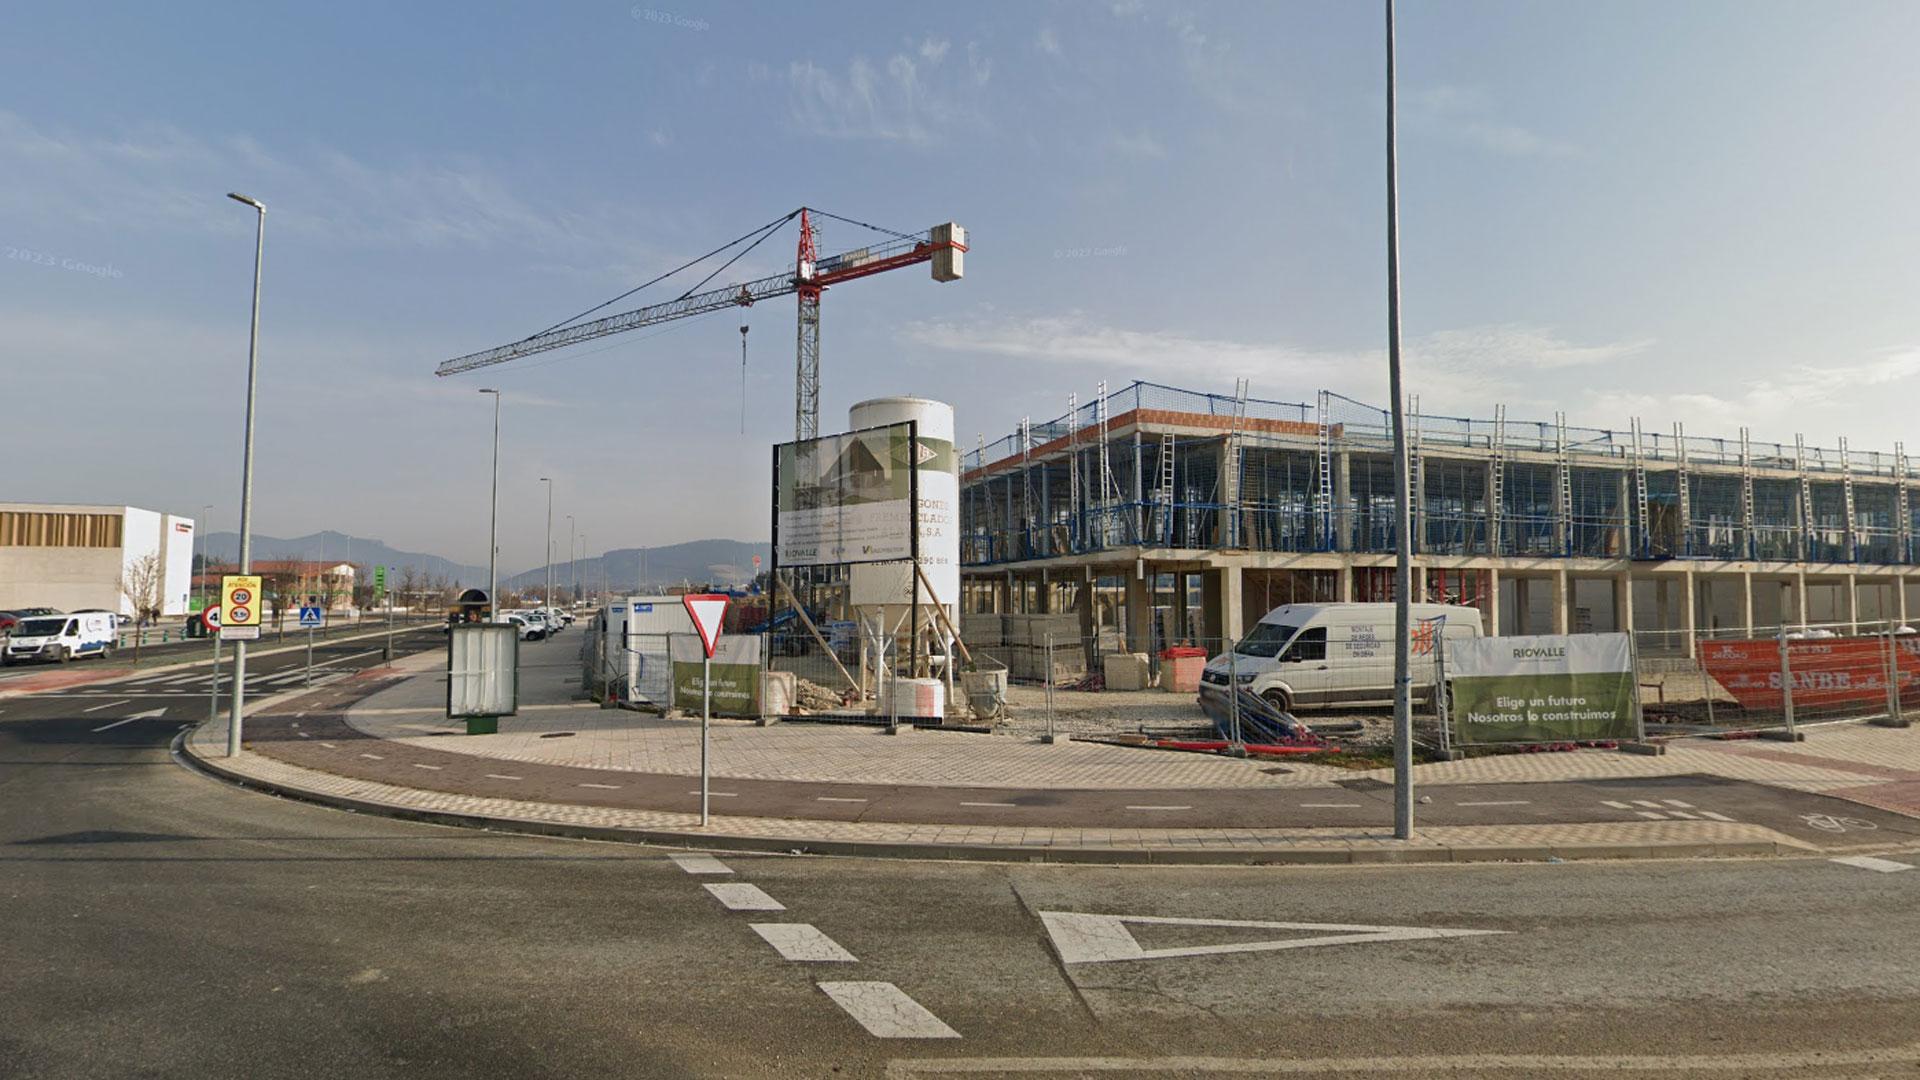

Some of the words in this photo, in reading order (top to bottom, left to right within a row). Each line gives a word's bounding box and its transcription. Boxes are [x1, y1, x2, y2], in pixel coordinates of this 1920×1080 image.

[236, 592, 247, 601] 20
[209, 612, 218, 621] 4
[1513, 647, 1566, 659] RIOVALLE
[1497, 697, 1525, 710] Elige
[1530, 698, 1545, 707] un
[1548, 695, 1586, 706] futuro
[1467, 712, 1524, 723] Nosotros
[1527, 710, 1539, 721] lo
[1542, 709, 1617, 720] construimos
